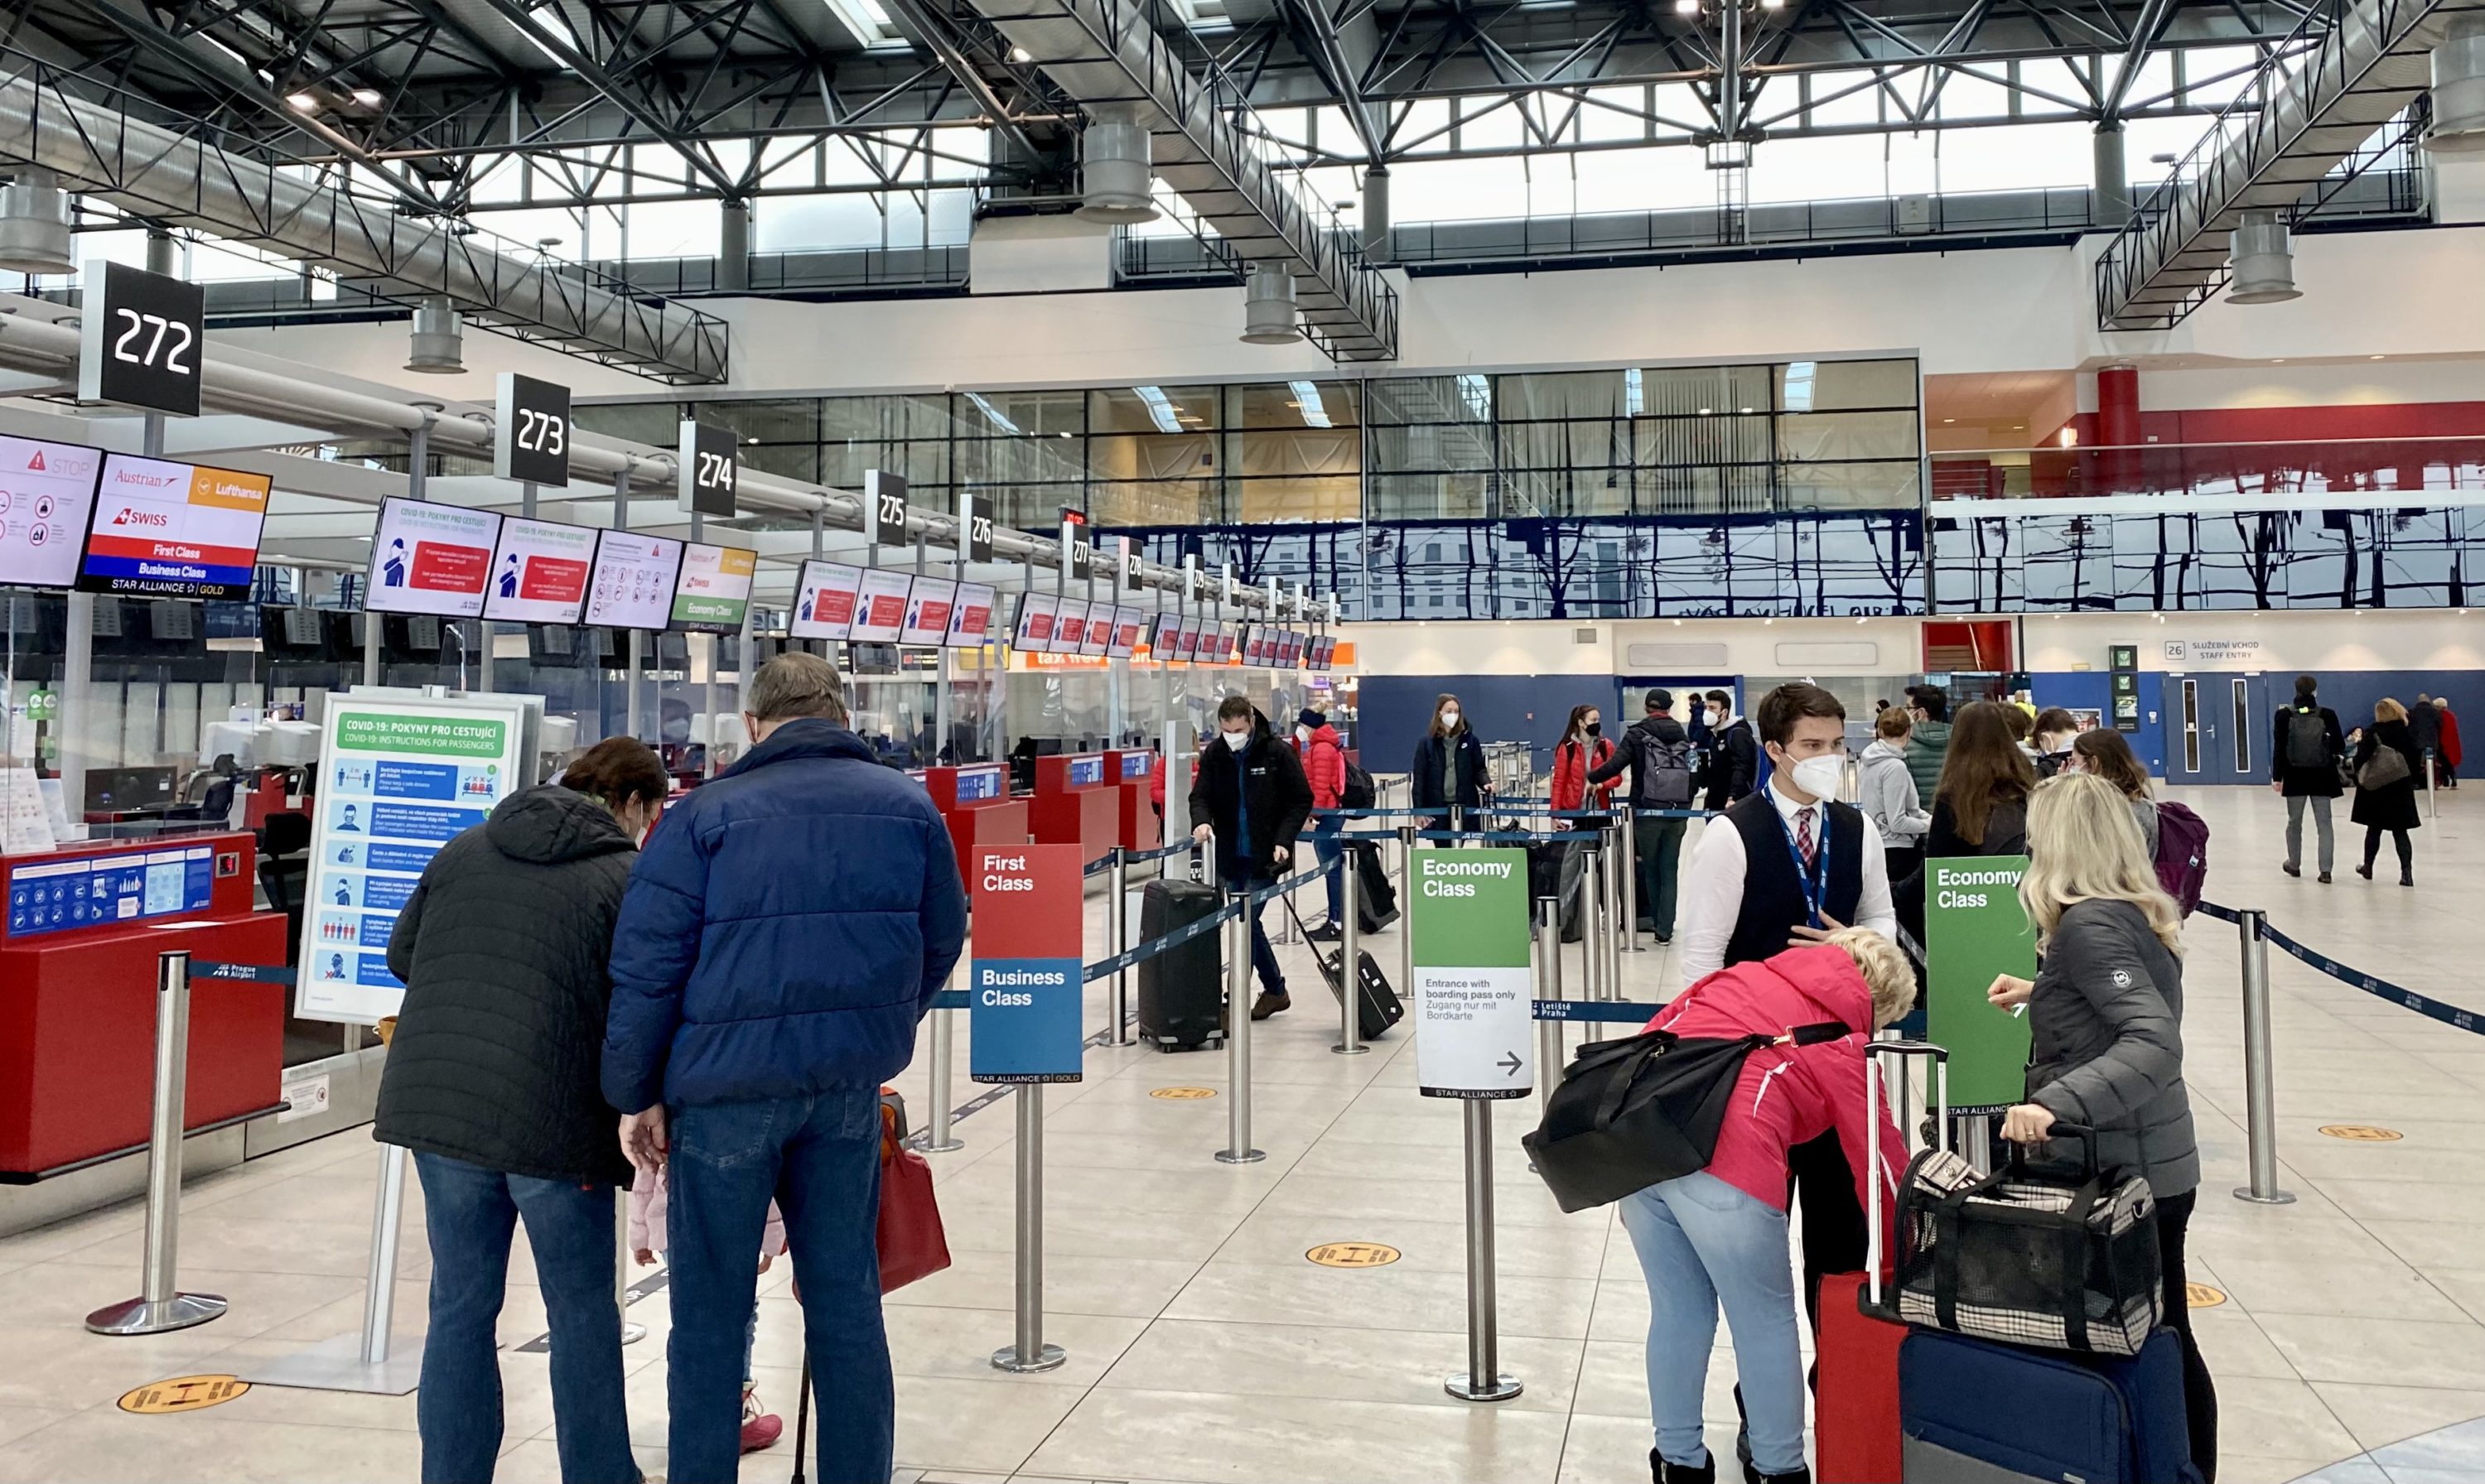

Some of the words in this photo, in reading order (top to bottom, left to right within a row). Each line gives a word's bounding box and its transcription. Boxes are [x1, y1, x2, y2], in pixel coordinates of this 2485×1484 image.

[114, 308, 192, 374] 272
[518, 408, 564, 455] 273
[52, 459, 89, 475] STOP
[698, 451, 733, 491] 274
[115, 470, 162, 487] Austrian
[215, 482, 263, 500] Lufthansa
[880, 494, 904, 526] 275
[131, 511, 167, 527] SWISS
[972, 516, 992, 544] 276
[153, 543, 175, 557] First
[175, 546, 200, 559] Class
[1074, 540, 1088, 563] 277
[138, 561, 179, 576] Business
[181, 565, 206, 579] Class
[1129, 554, 1142, 576] 278
[112, 578, 136, 590] STAR
[138, 580, 185, 594] ALLIANCE
[200, 584, 224, 595] GOLD
[688, 602, 717, 617] Economy
[717, 605, 733, 616] Class
[2168, 646, 2182, 655] 26
[2193, 640, 2230, 649] SLUŽEBNÍ
[346, 720, 388, 732] COVID-19:
[391, 722, 429, 735] POKYNY
[431, 725, 451, 735] PRO
[453, 726, 497, 739] CESTUJÍCÍ
[345, 733, 378, 743] COVID-19:
[379, 735, 431, 747] INSTRUCTIONS
[432, 739, 447, 748] FOR
[449, 740, 495, 750] PASSENGERS
[983, 855, 1026, 871] First
[1422, 859, 1513, 879] Economy
[983, 874, 1034, 891] Class
[1937, 867, 2022, 889] Economy
[1423, 880, 1476, 898] Class
[1937, 890, 1988, 908] Class
[230, 971, 255, 979] Airport
[231, 965, 256, 973] Prague
[982, 969, 1065, 986] Business
[1426, 979, 1467, 988] Entrance
[1470, 979, 1490, 988] with
[982, 990, 1032, 1006] Class
[1426, 990, 1468, 1000] boarding
[1470, 991, 1493, 1000] pass
[1495, 990, 1516, 1000] only
[1426, 1000, 1461, 1011] Zugang
[1482, 1000, 1497, 1009] mit
[1542, 1002, 1571, 1010] Letiště
[1542, 1009, 1566, 1018] Praha
[1426, 1011, 1474, 1021] Bordkarte
[1436, 1089, 1458, 1097] STAR
[1460, 1089, 1507, 1099] ALLIANCE
[1947, 1107, 1968, 1115] STAR
